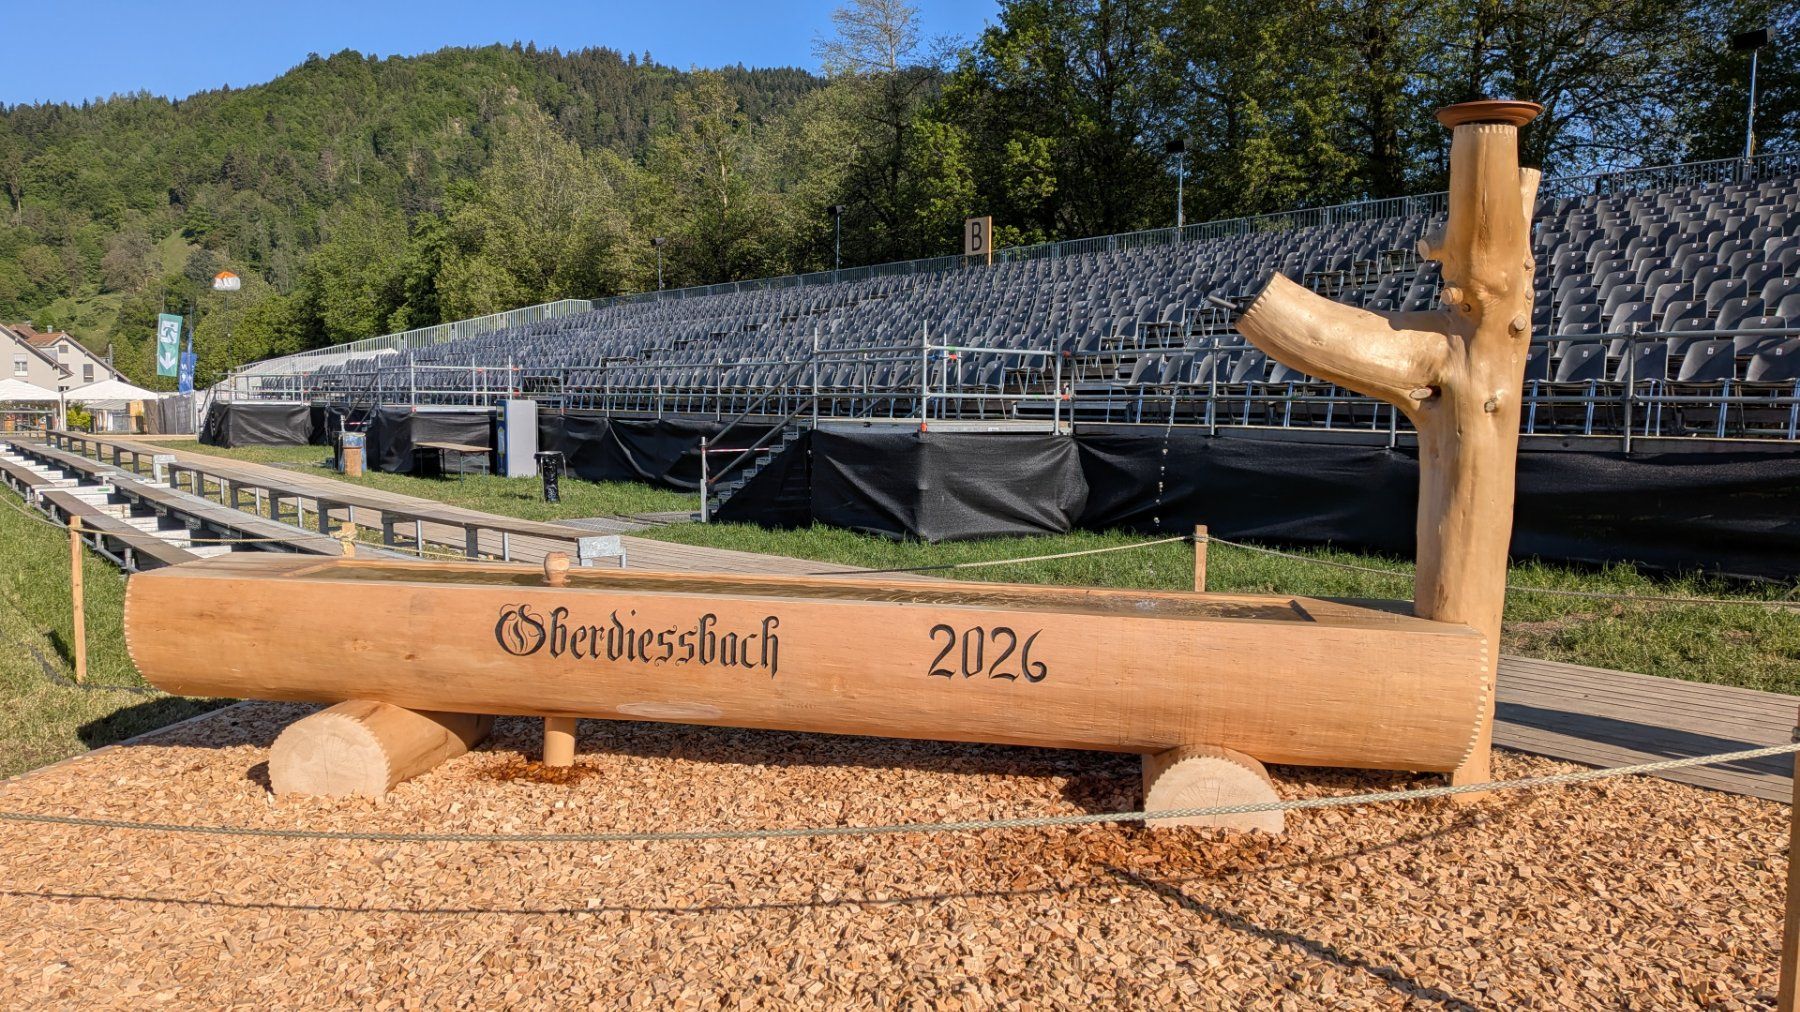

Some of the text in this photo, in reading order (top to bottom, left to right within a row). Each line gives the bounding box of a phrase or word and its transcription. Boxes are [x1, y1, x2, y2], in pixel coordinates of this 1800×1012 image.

[972, 221, 982, 252] B
[494, 603, 1048, 683] Oberdiessbach 2026
